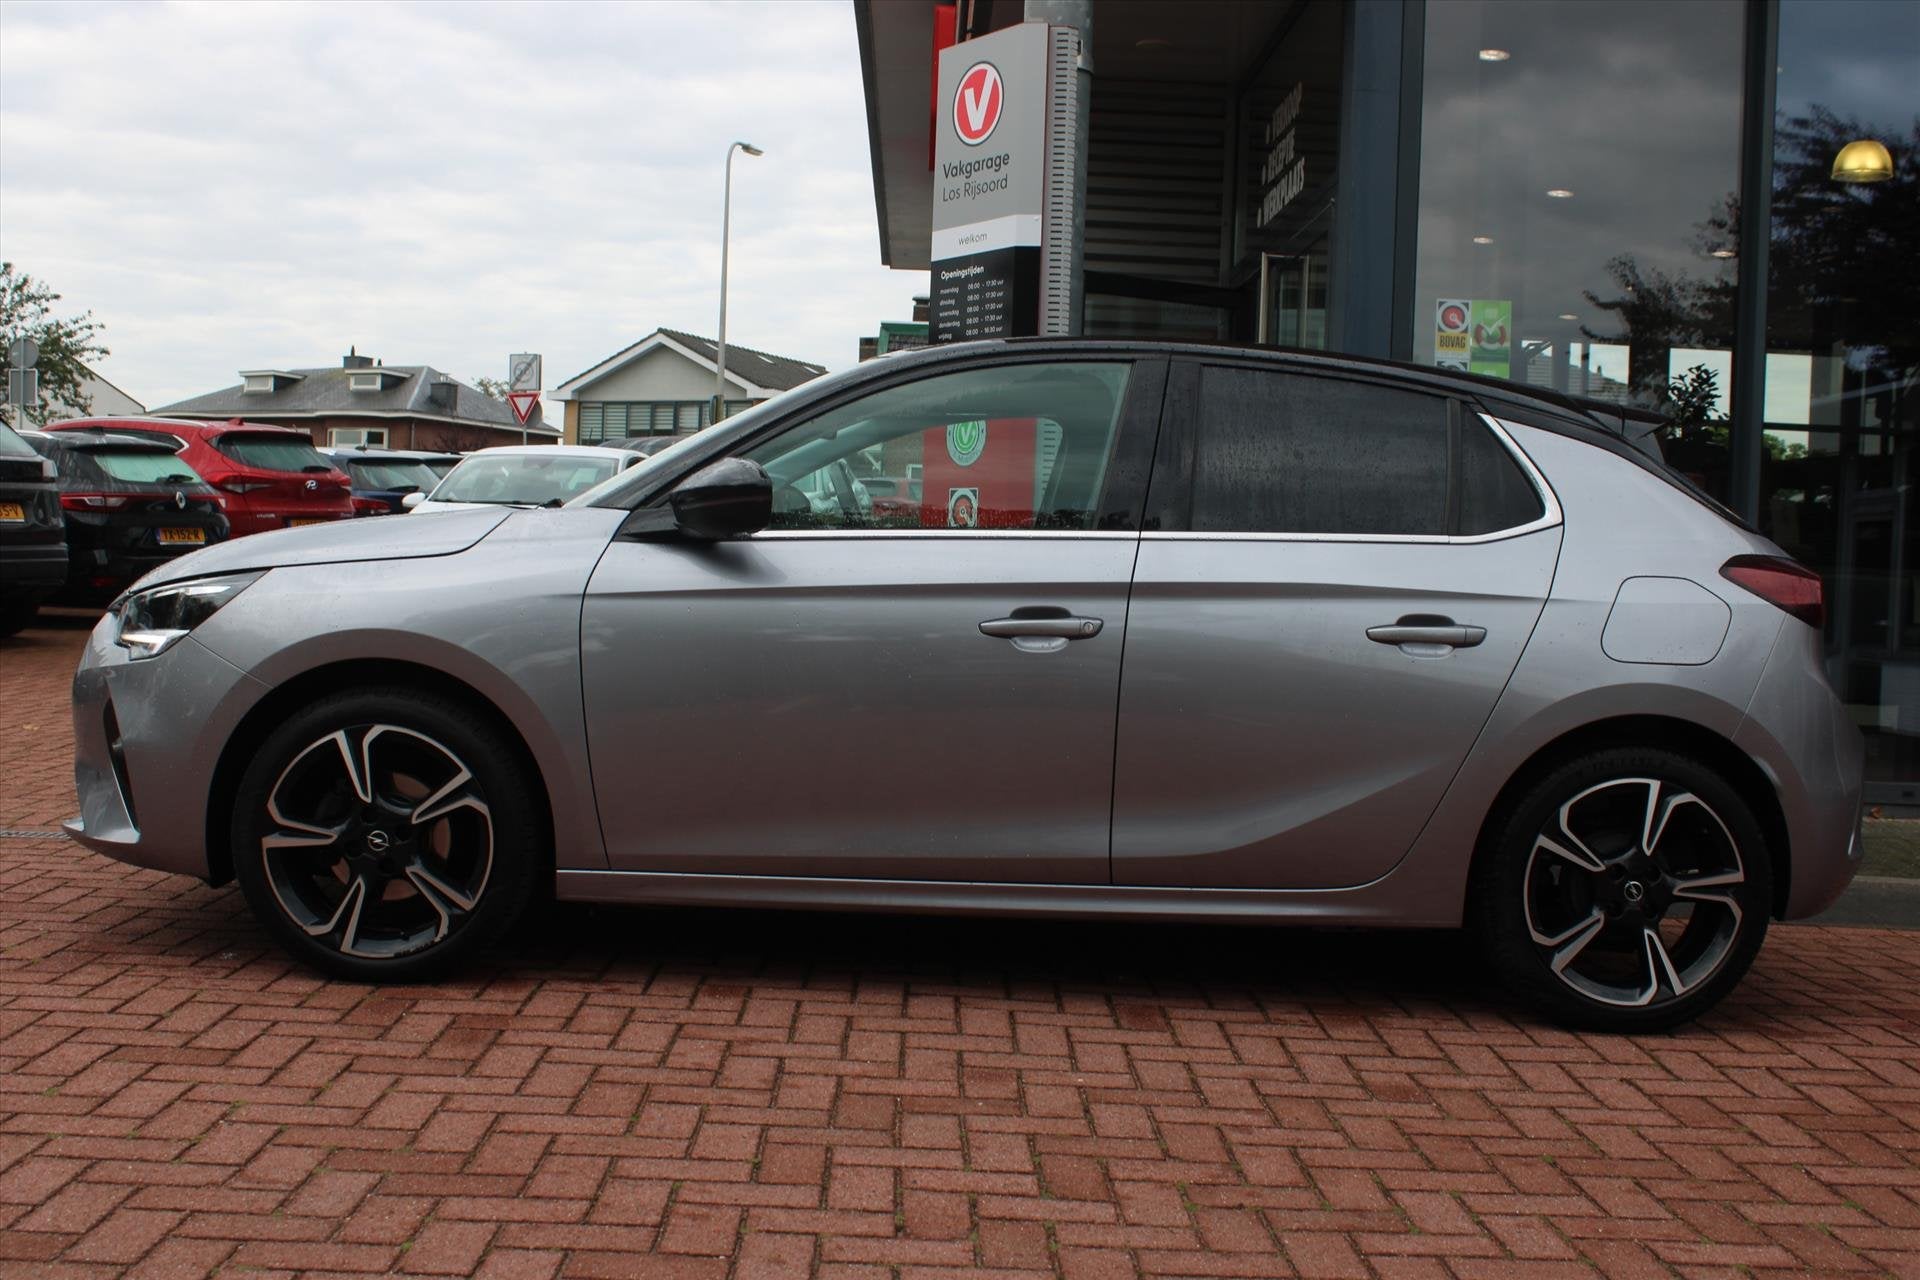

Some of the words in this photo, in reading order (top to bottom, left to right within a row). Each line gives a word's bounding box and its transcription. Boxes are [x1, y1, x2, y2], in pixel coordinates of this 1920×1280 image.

[942, 153, 1010, 179] Vakgarage
[942, 187, 961, 202] Los
[963, 173, 1008, 200] Rijsoord
[958, 232, 988, 246] welkom
[940, 266, 985, 280] Openingstijden
[1439, 335, 1466, 349] BOVAG
